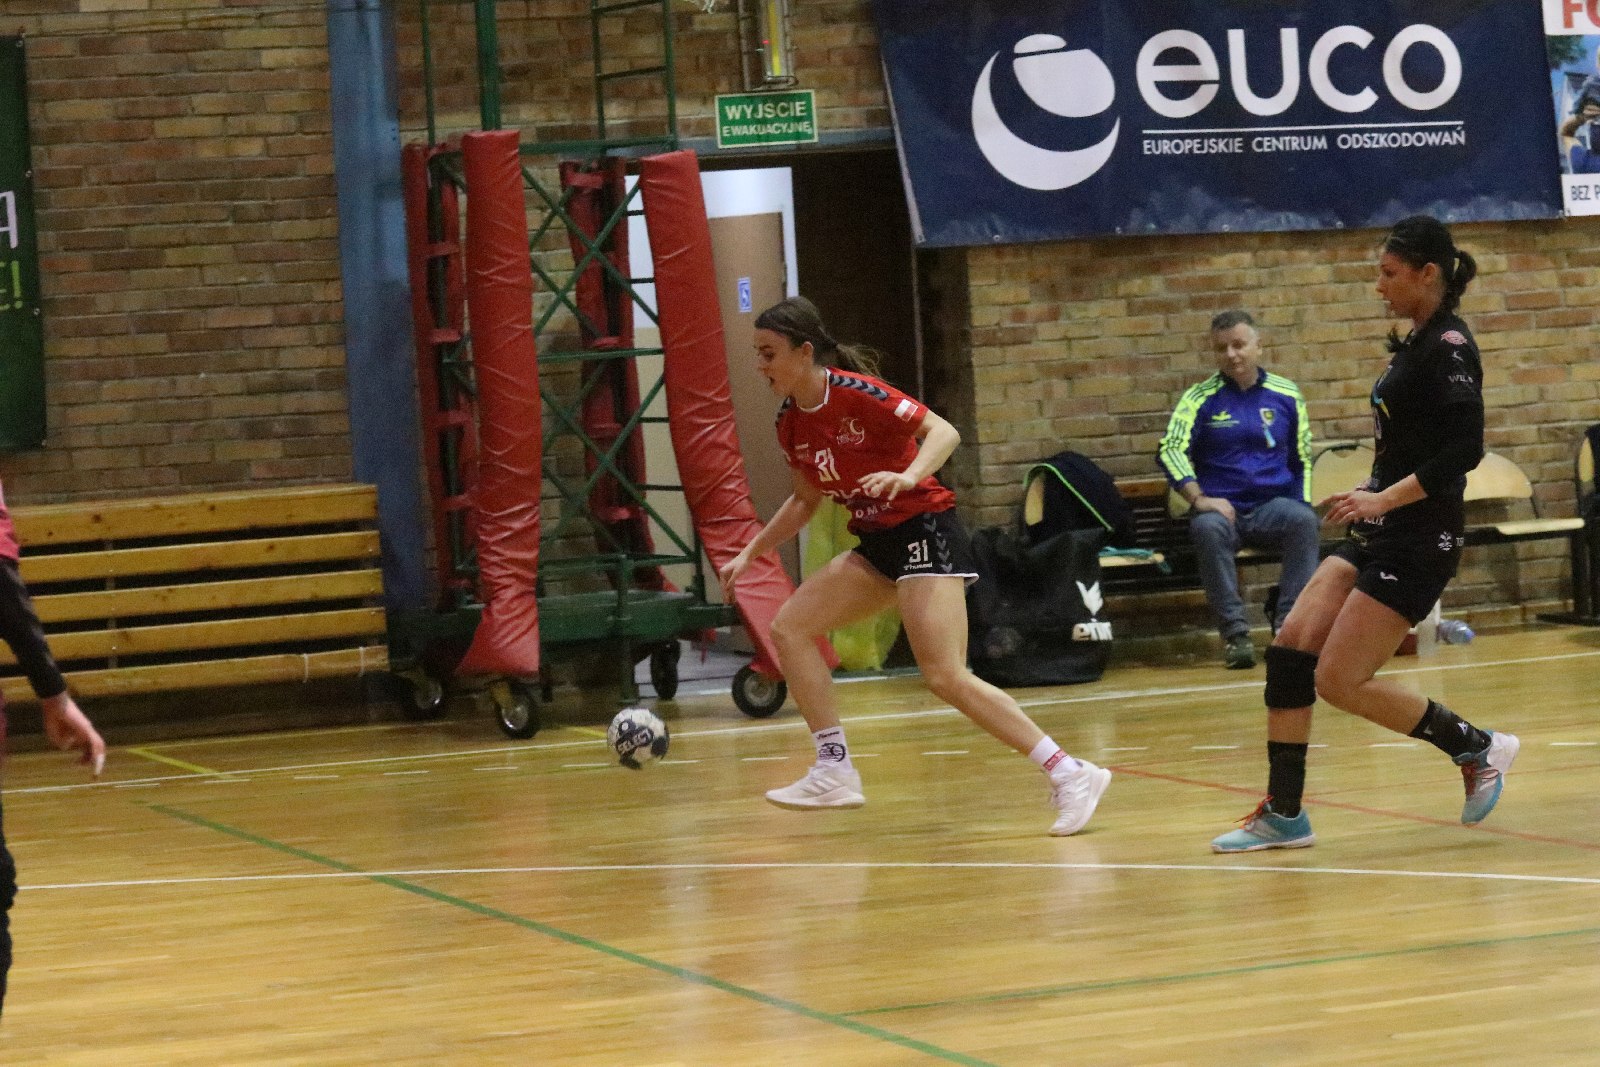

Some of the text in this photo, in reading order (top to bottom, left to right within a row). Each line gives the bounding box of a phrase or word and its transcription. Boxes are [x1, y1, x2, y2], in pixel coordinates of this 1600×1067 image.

[1136, 23, 1463, 118] euco
[722, 121, 813, 137] EWAKUACYJNE
[1143, 127, 1466, 154] EUROPEJSKIE CENTRUM ODSZKODOWAŃ
[814, 447, 841, 482] 31
[907, 539, 929, 563] 31
